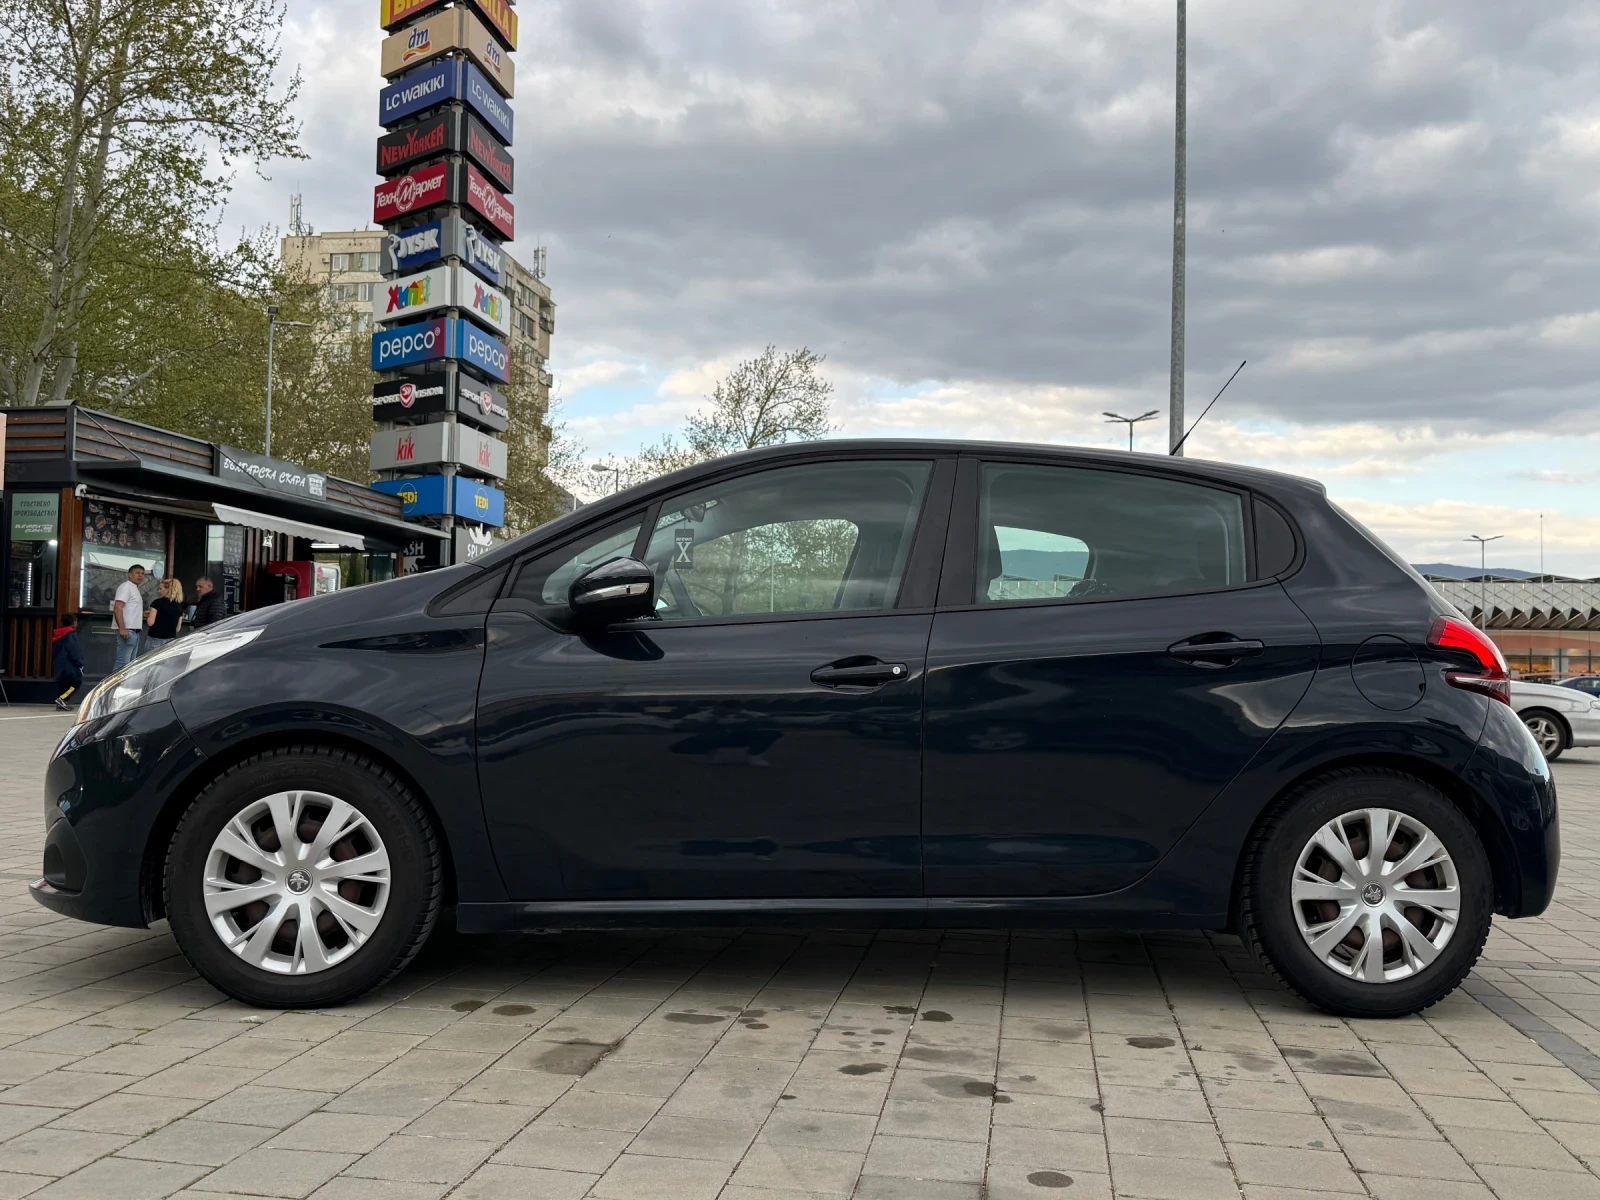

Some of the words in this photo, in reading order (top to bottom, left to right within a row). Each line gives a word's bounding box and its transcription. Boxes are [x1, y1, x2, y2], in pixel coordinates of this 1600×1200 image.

[408, 28, 429, 48] dm
[487, 38, 501, 66] dm
[386, 94, 401, 111] LC
[397, 229, 439, 258] JYSK
[474, 239, 501, 273] JYSK
[373, 394, 401, 406] SPORT
[414, 386, 444, 399] VISION
[279, 472, 307, 488] СКАРА
[475, 494, 489, 510] TEDi
[403, 541, 425, 556] ASH
[675, 542, 691, 562] X
